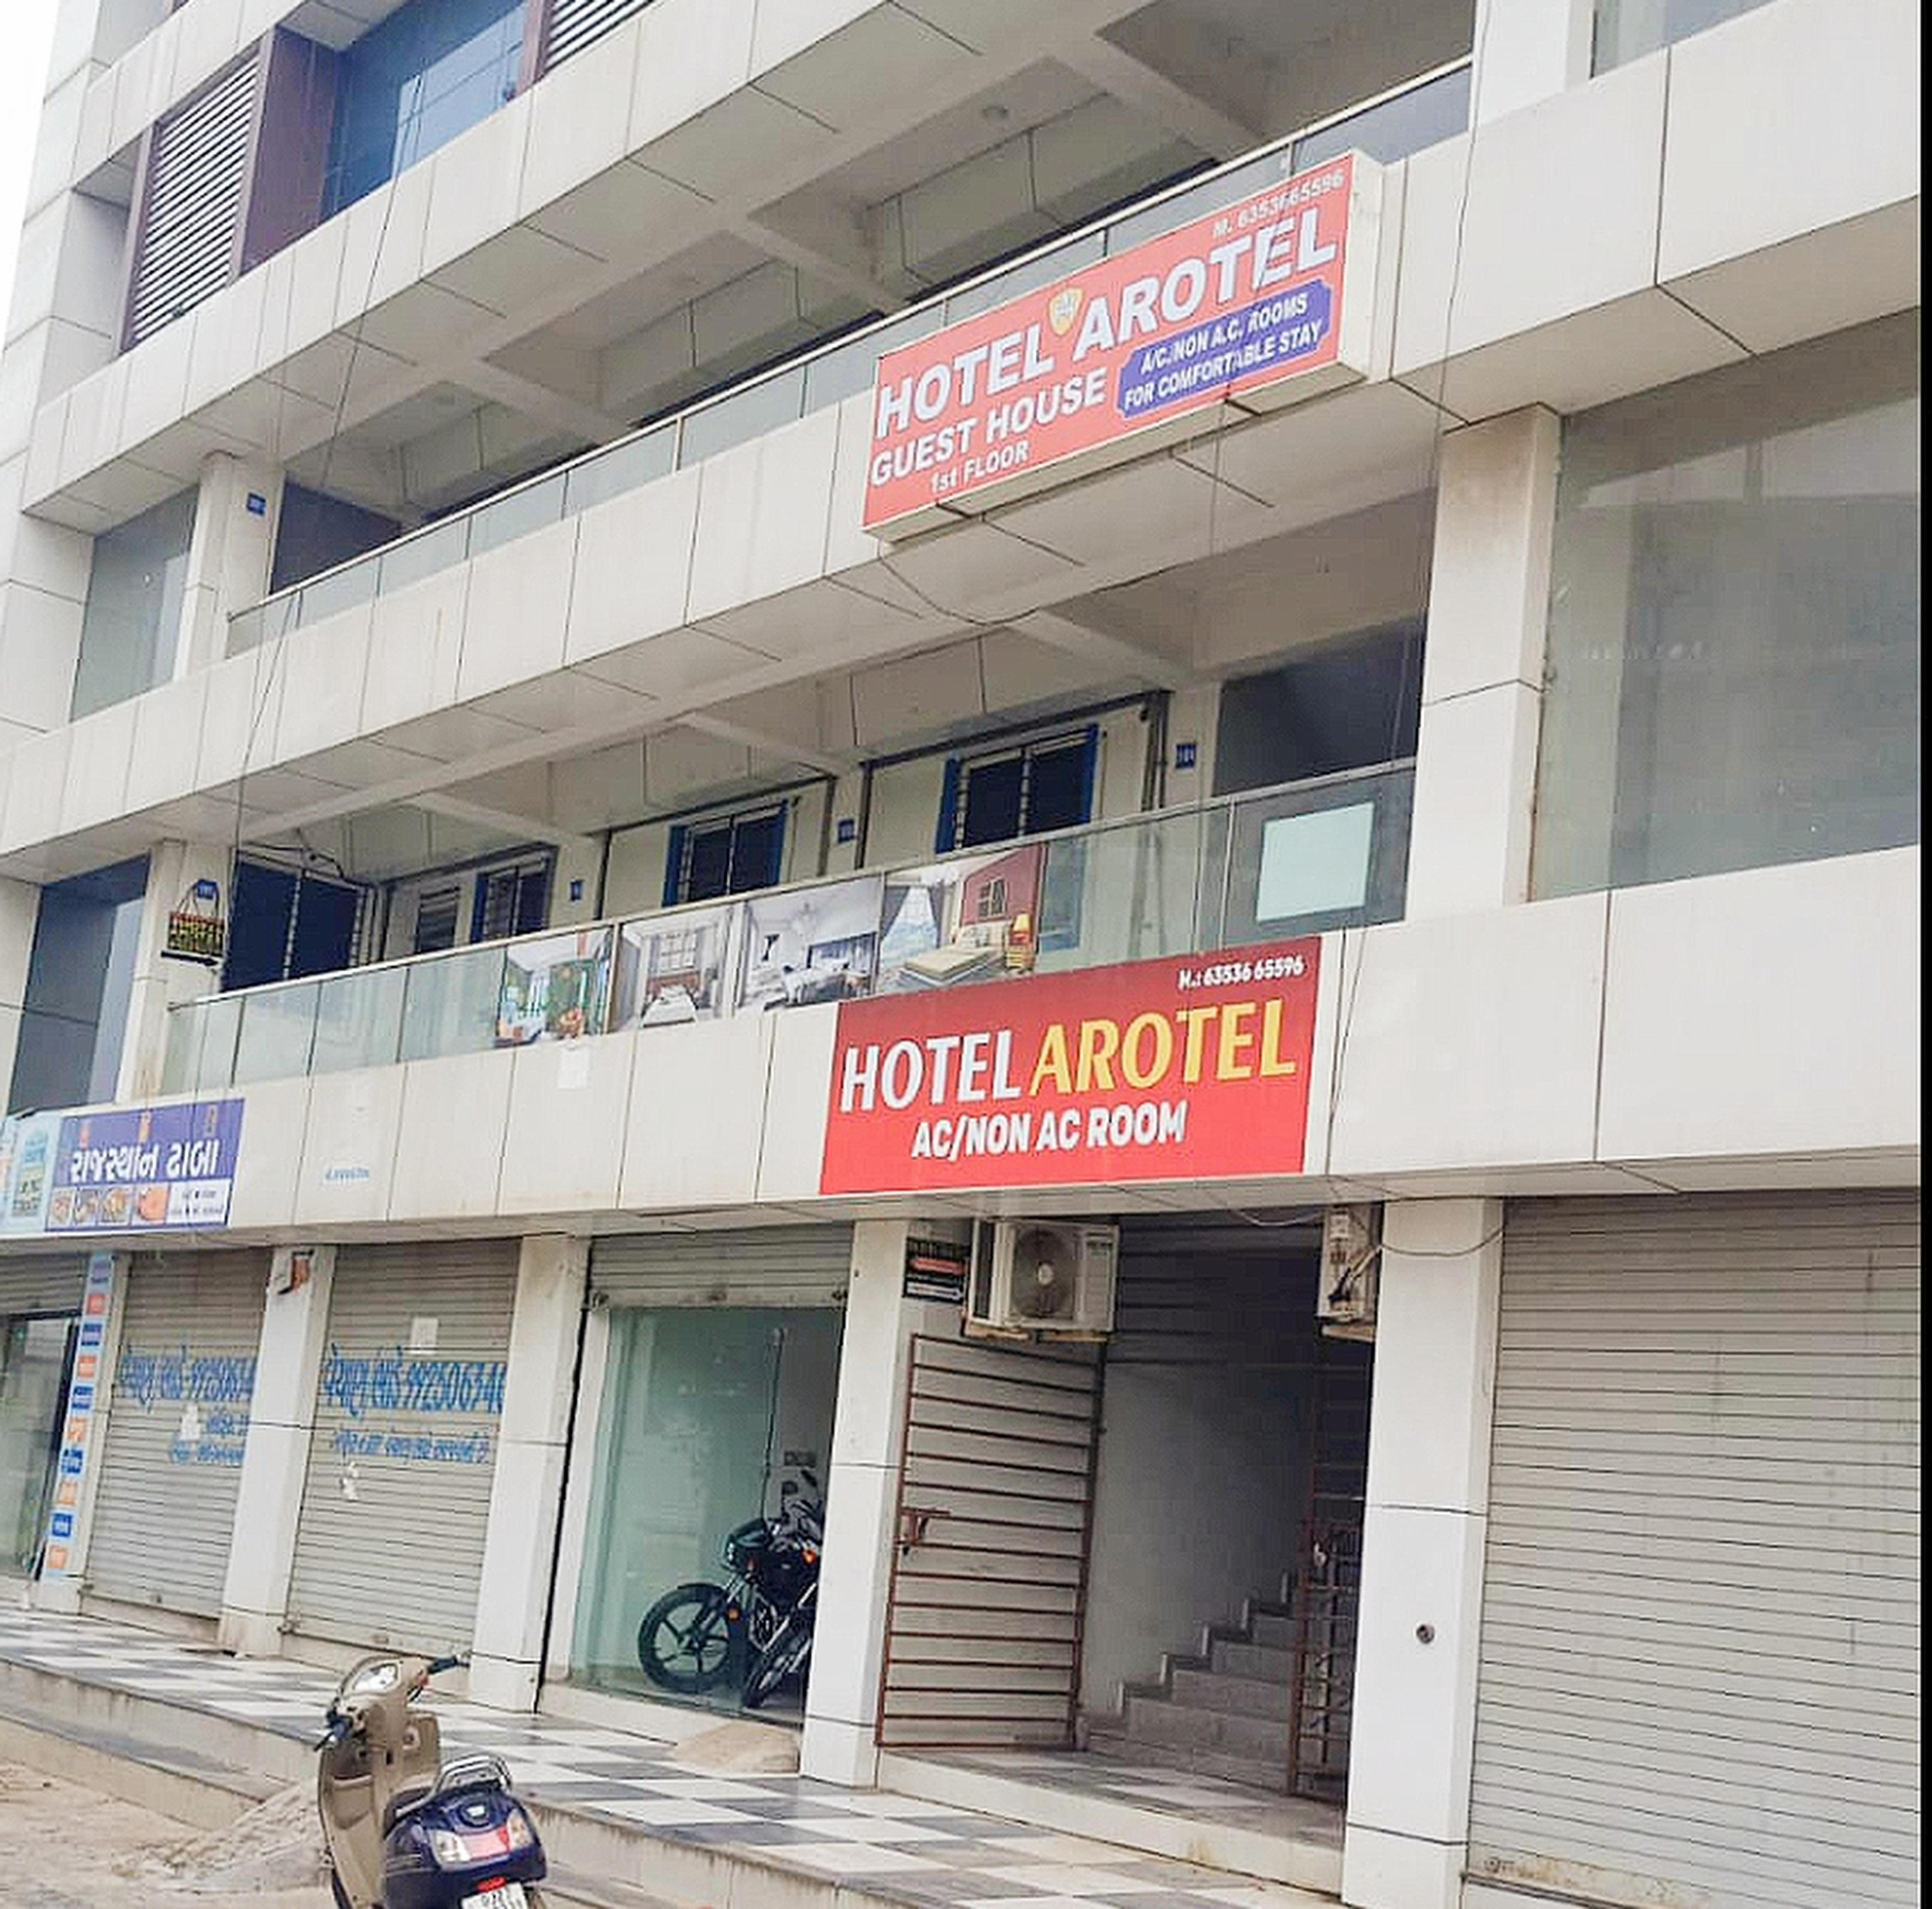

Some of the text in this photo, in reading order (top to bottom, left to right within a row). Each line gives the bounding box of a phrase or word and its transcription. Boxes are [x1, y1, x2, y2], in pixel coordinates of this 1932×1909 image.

[876, 207, 1337, 438] HOTEL AROTEL
[1248, 292, 1308, 333] ROOMS
[1124, 319, 1322, 410] FOR COMFORTABLE STAY
[871, 368, 1107, 486] GUEST HOUSE
[932, 440, 1029, 493] 1st FLOOR
[839, 998, 1297, 1114] HOTEL AROTEL
[911, 1099, 1189, 1162] AC/NON AC ROOM
